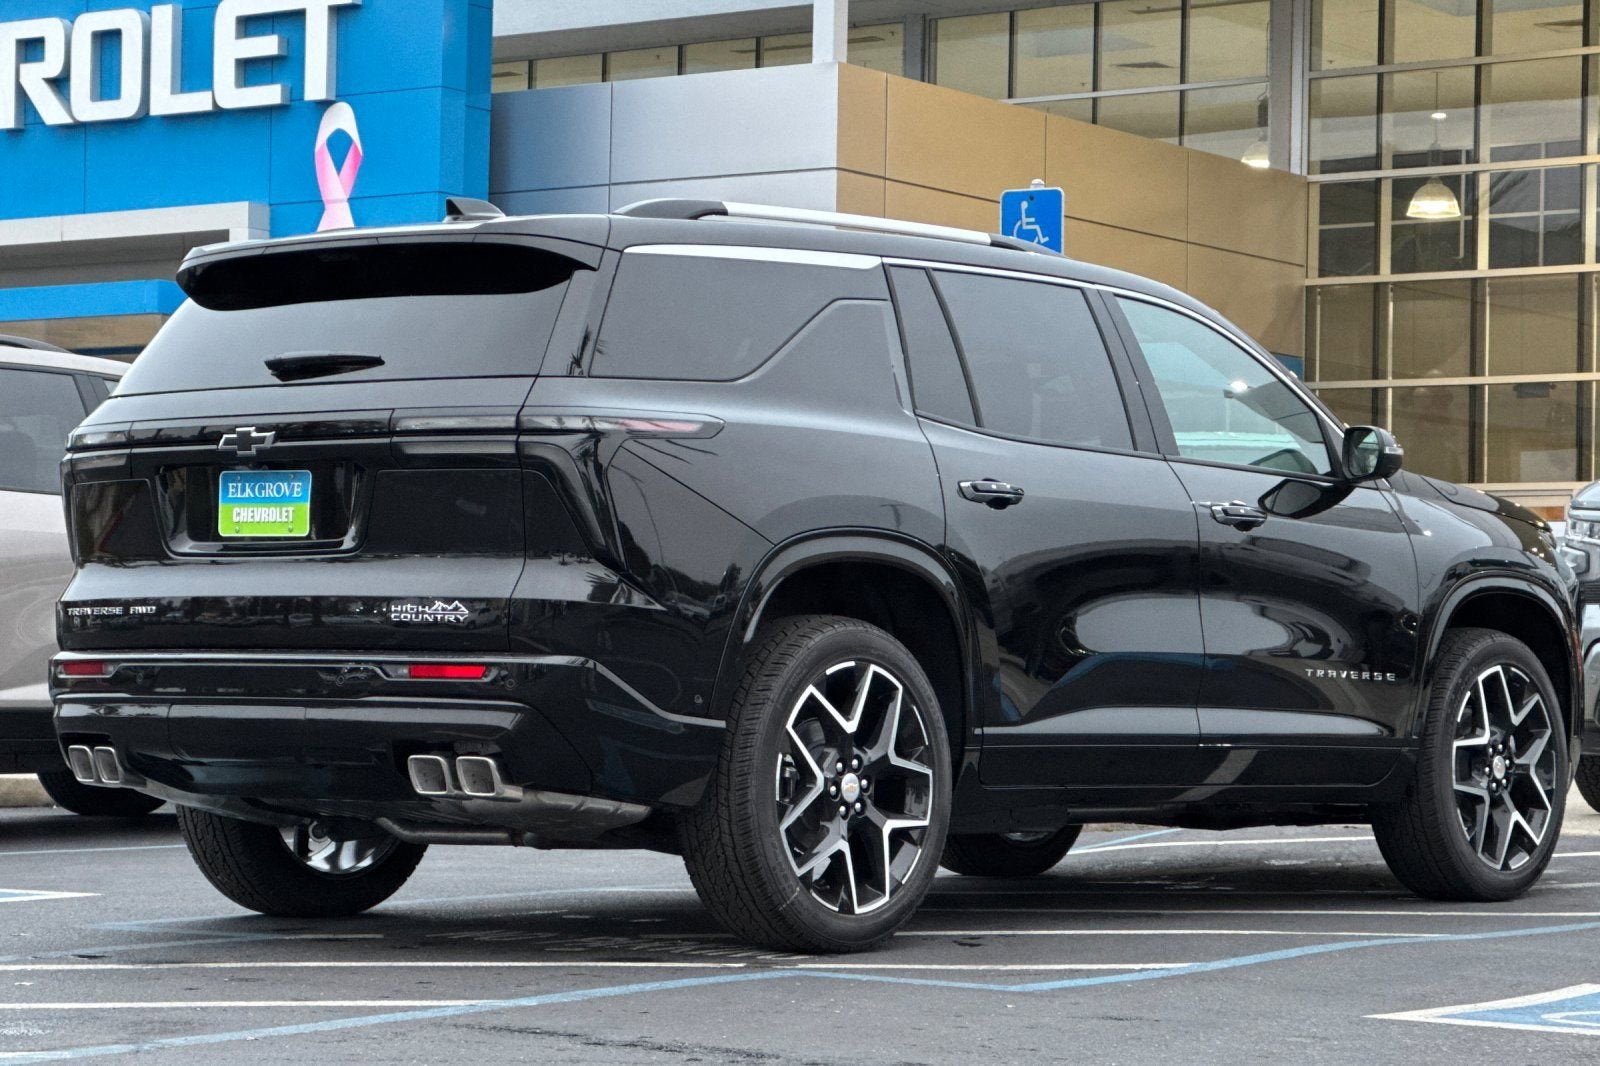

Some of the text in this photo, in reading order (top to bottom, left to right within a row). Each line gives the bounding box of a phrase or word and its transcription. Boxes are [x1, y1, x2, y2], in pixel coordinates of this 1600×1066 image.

[233, 507, 294, 522] CHEVROLET
[67, 606, 156, 616] TRAVERSE AWD
[391, 605, 430, 613] HIGH
[391, 613, 469, 622] COUNTRY
[1304, 668, 1396, 680] TRAVERSE
